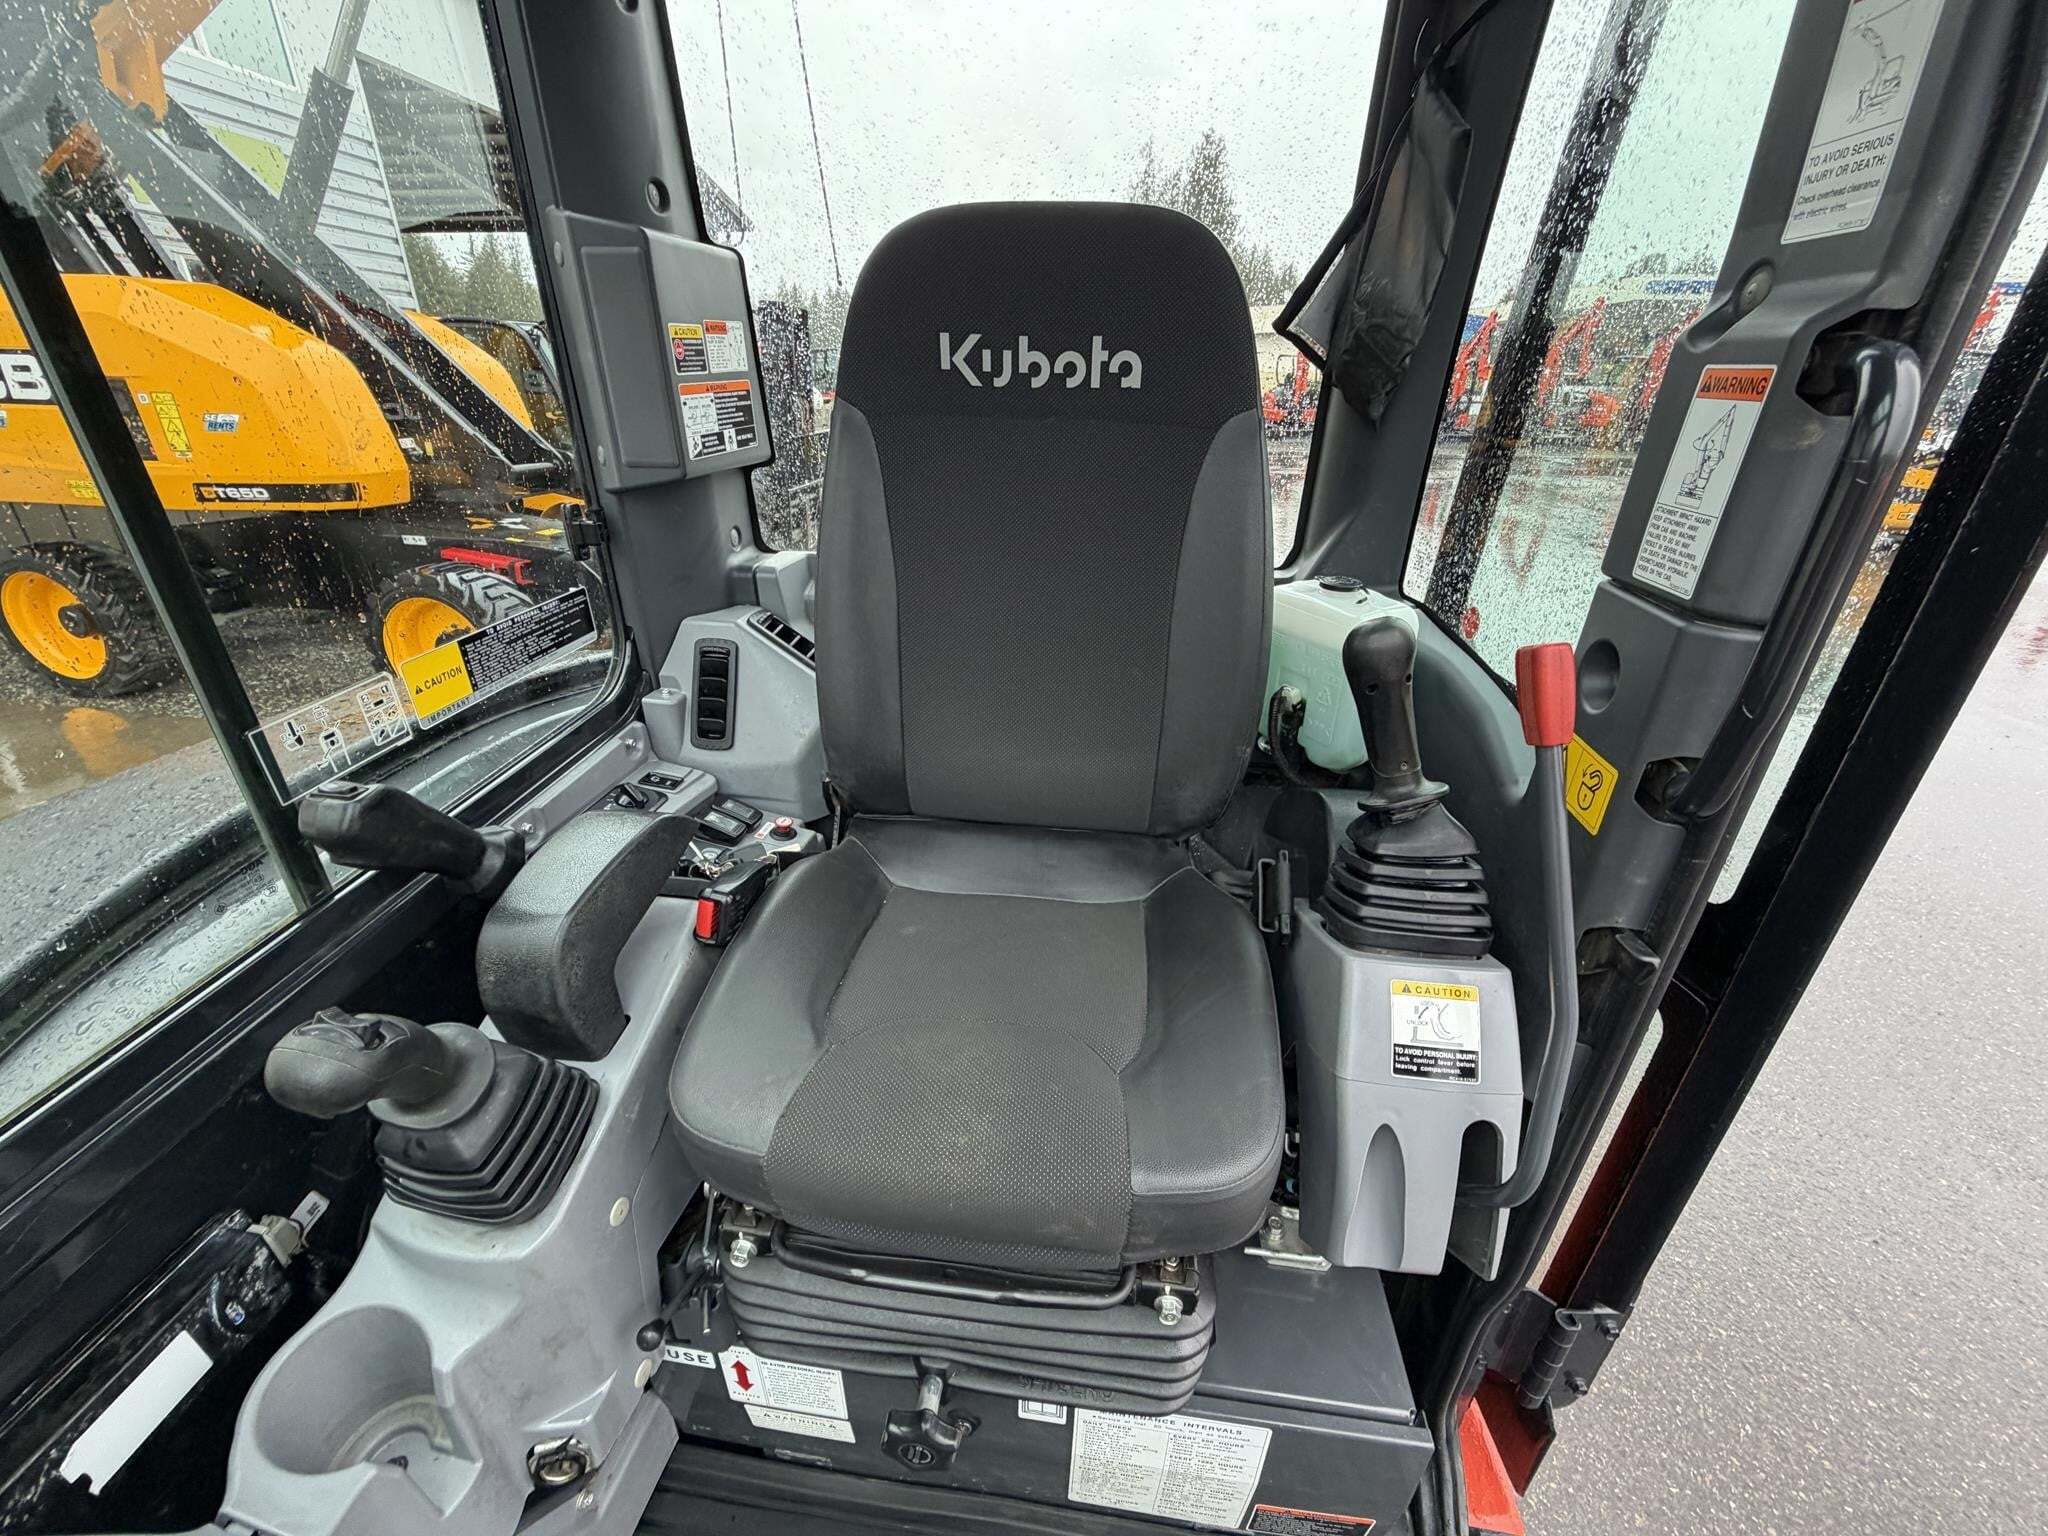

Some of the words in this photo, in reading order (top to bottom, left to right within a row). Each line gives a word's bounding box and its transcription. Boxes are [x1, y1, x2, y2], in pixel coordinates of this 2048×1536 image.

[1809, 156, 1820, 168] TO
[1822, 147, 1850, 164] AVOID
[1851, 133, 1895, 156] SERIOUS
[1803, 167, 1834, 186] INJURY
[1835, 164, 1849, 177] OR
[1850, 153, 1888, 174] DEATH:
[939, 332, 1143, 389] Kubota
[1712, 376, 1769, 396] WARNING
[207, 421, 235, 430] RENTS
[486, 626, 496, 636] TO
[496, 619, 513, 633] AVOID
[514, 608, 541, 623] PERSONAL
[541, 600, 561, 613] INJURY:
[424, 665, 463, 690] CAUTION
[426, 696, 470, 724] IMPORTANT
[1415, 985, 1472, 998] CAUTION
[1404, 1048, 1423, 1056] AVOID
[1423, 1050, 1455, 1059] PERSONAL
[1413, 1057, 1435, 1065] control
[1395, 1063, 1417, 1072] leaving
[1183, 1421, 1243, 1436] INTERVALS
